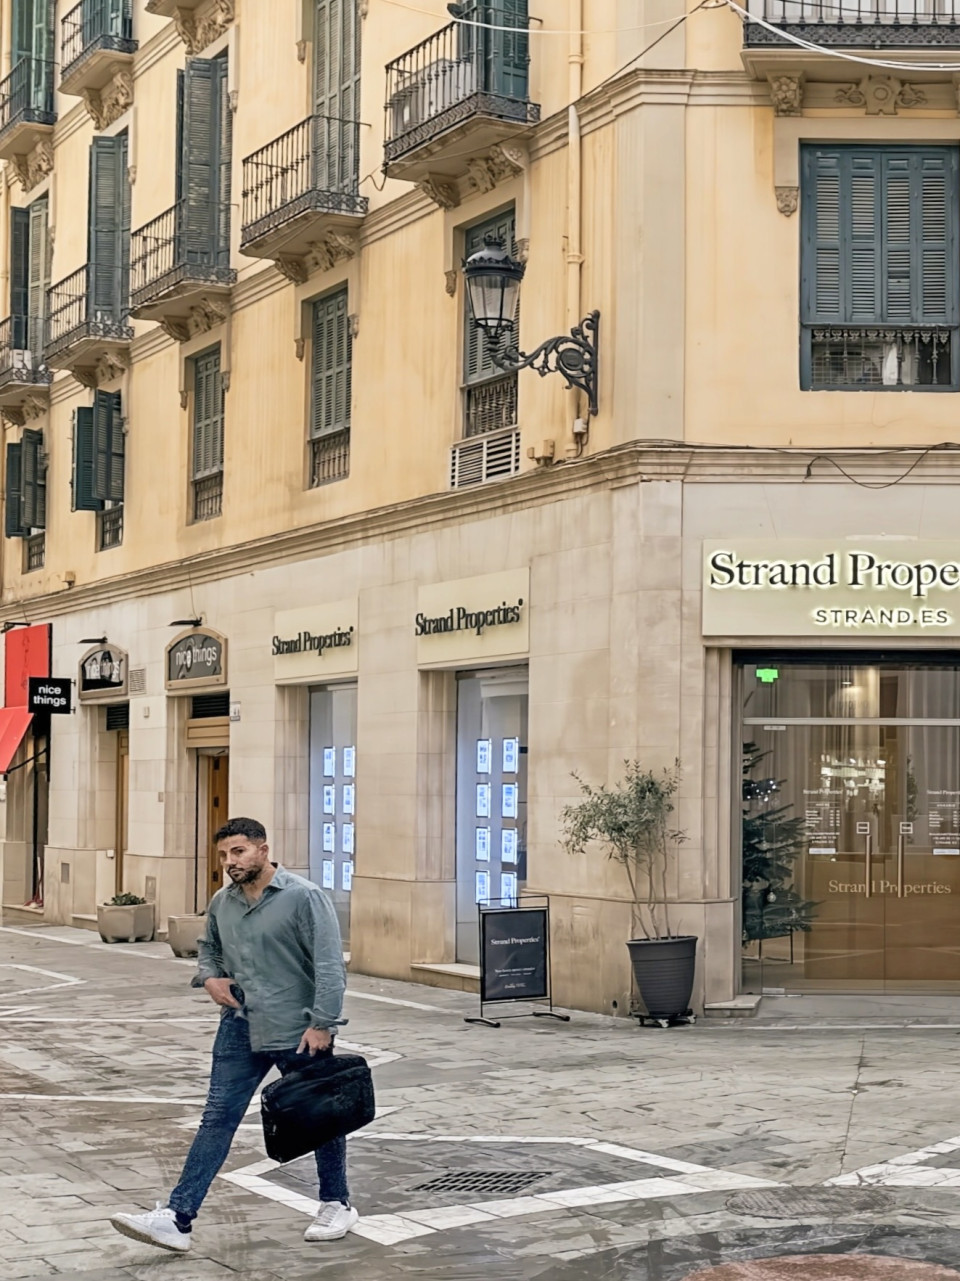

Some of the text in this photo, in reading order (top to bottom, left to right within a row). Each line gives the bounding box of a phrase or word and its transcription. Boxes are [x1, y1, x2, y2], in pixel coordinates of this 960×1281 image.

[710, 552, 837, 586] Strand
[415, 608, 454, 636] Strand
[815, 609, 948, 624] STRAND.ES
[272, 632, 301, 656] Strand
[176, 645, 217, 667] nice things
[38, 684, 62, 695] nice
[33, 695, 67, 707] things
